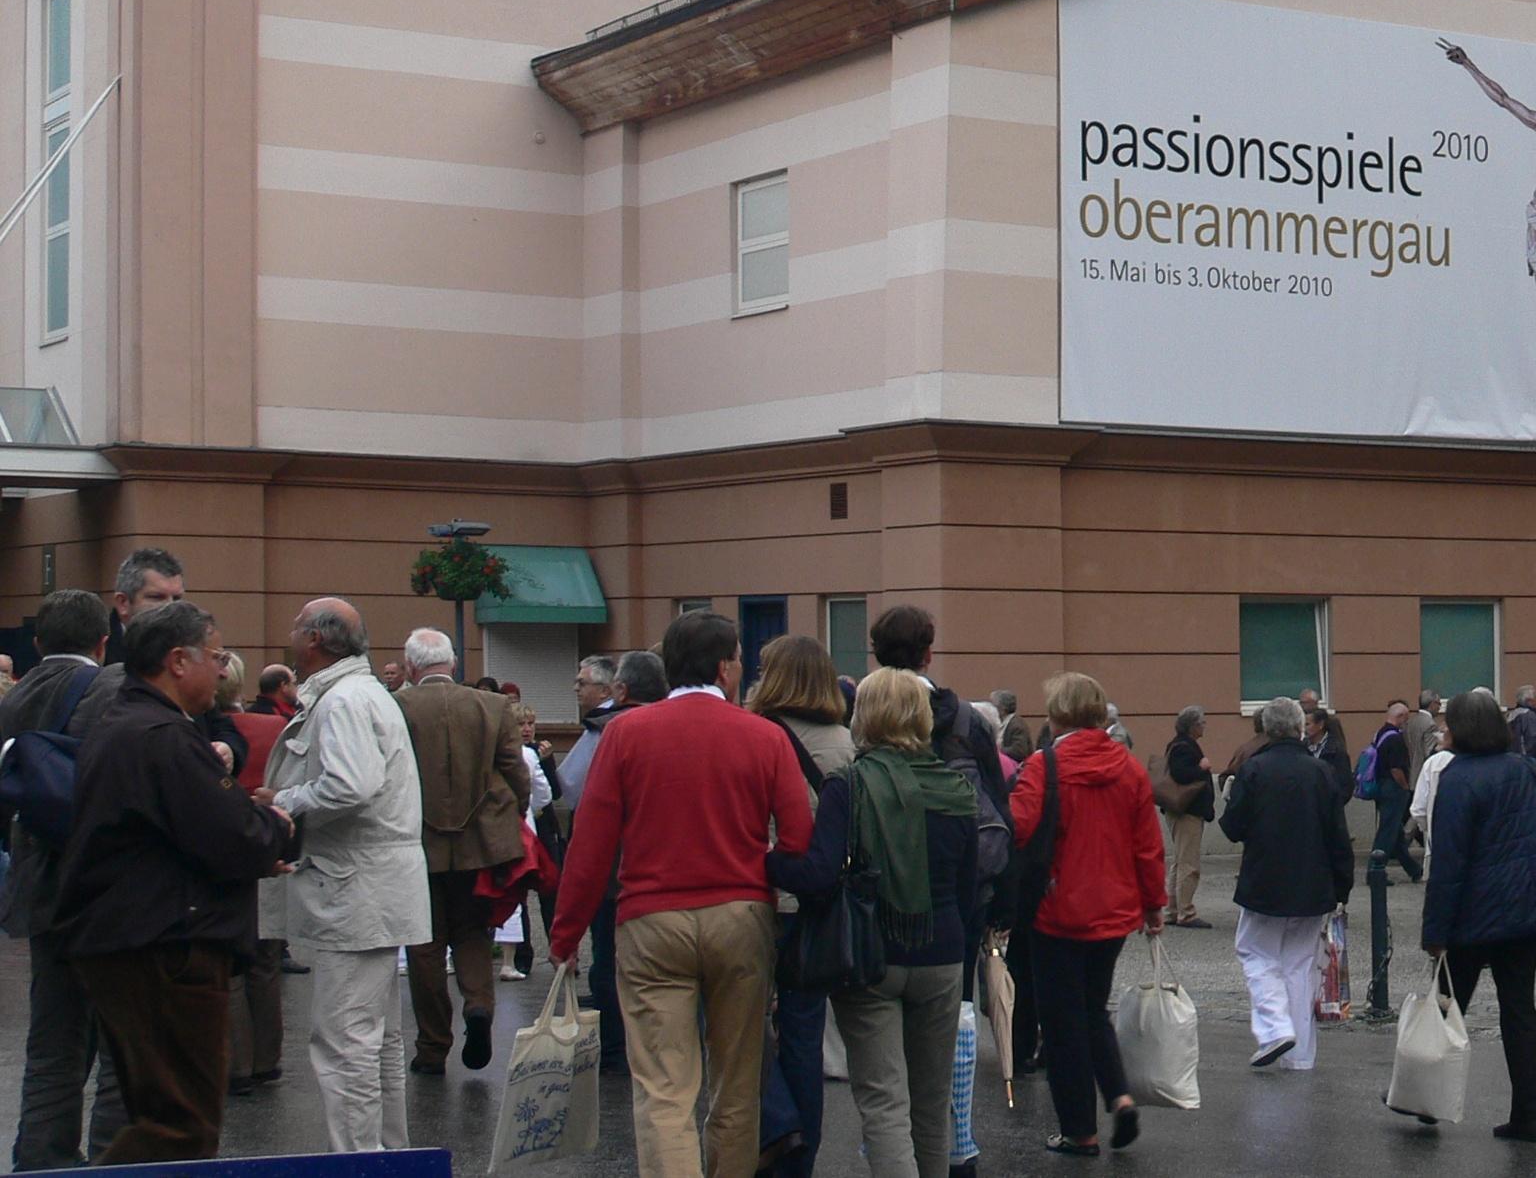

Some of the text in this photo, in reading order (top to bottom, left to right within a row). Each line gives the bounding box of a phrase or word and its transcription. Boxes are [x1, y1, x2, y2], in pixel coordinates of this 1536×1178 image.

[1080, 114, 1489, 205] passionsspiele 2010
[1079, 178, 1451, 278] oberammergau
[1080, 258, 1333, 297] 15. Mai bis 3. Oktober 2010
